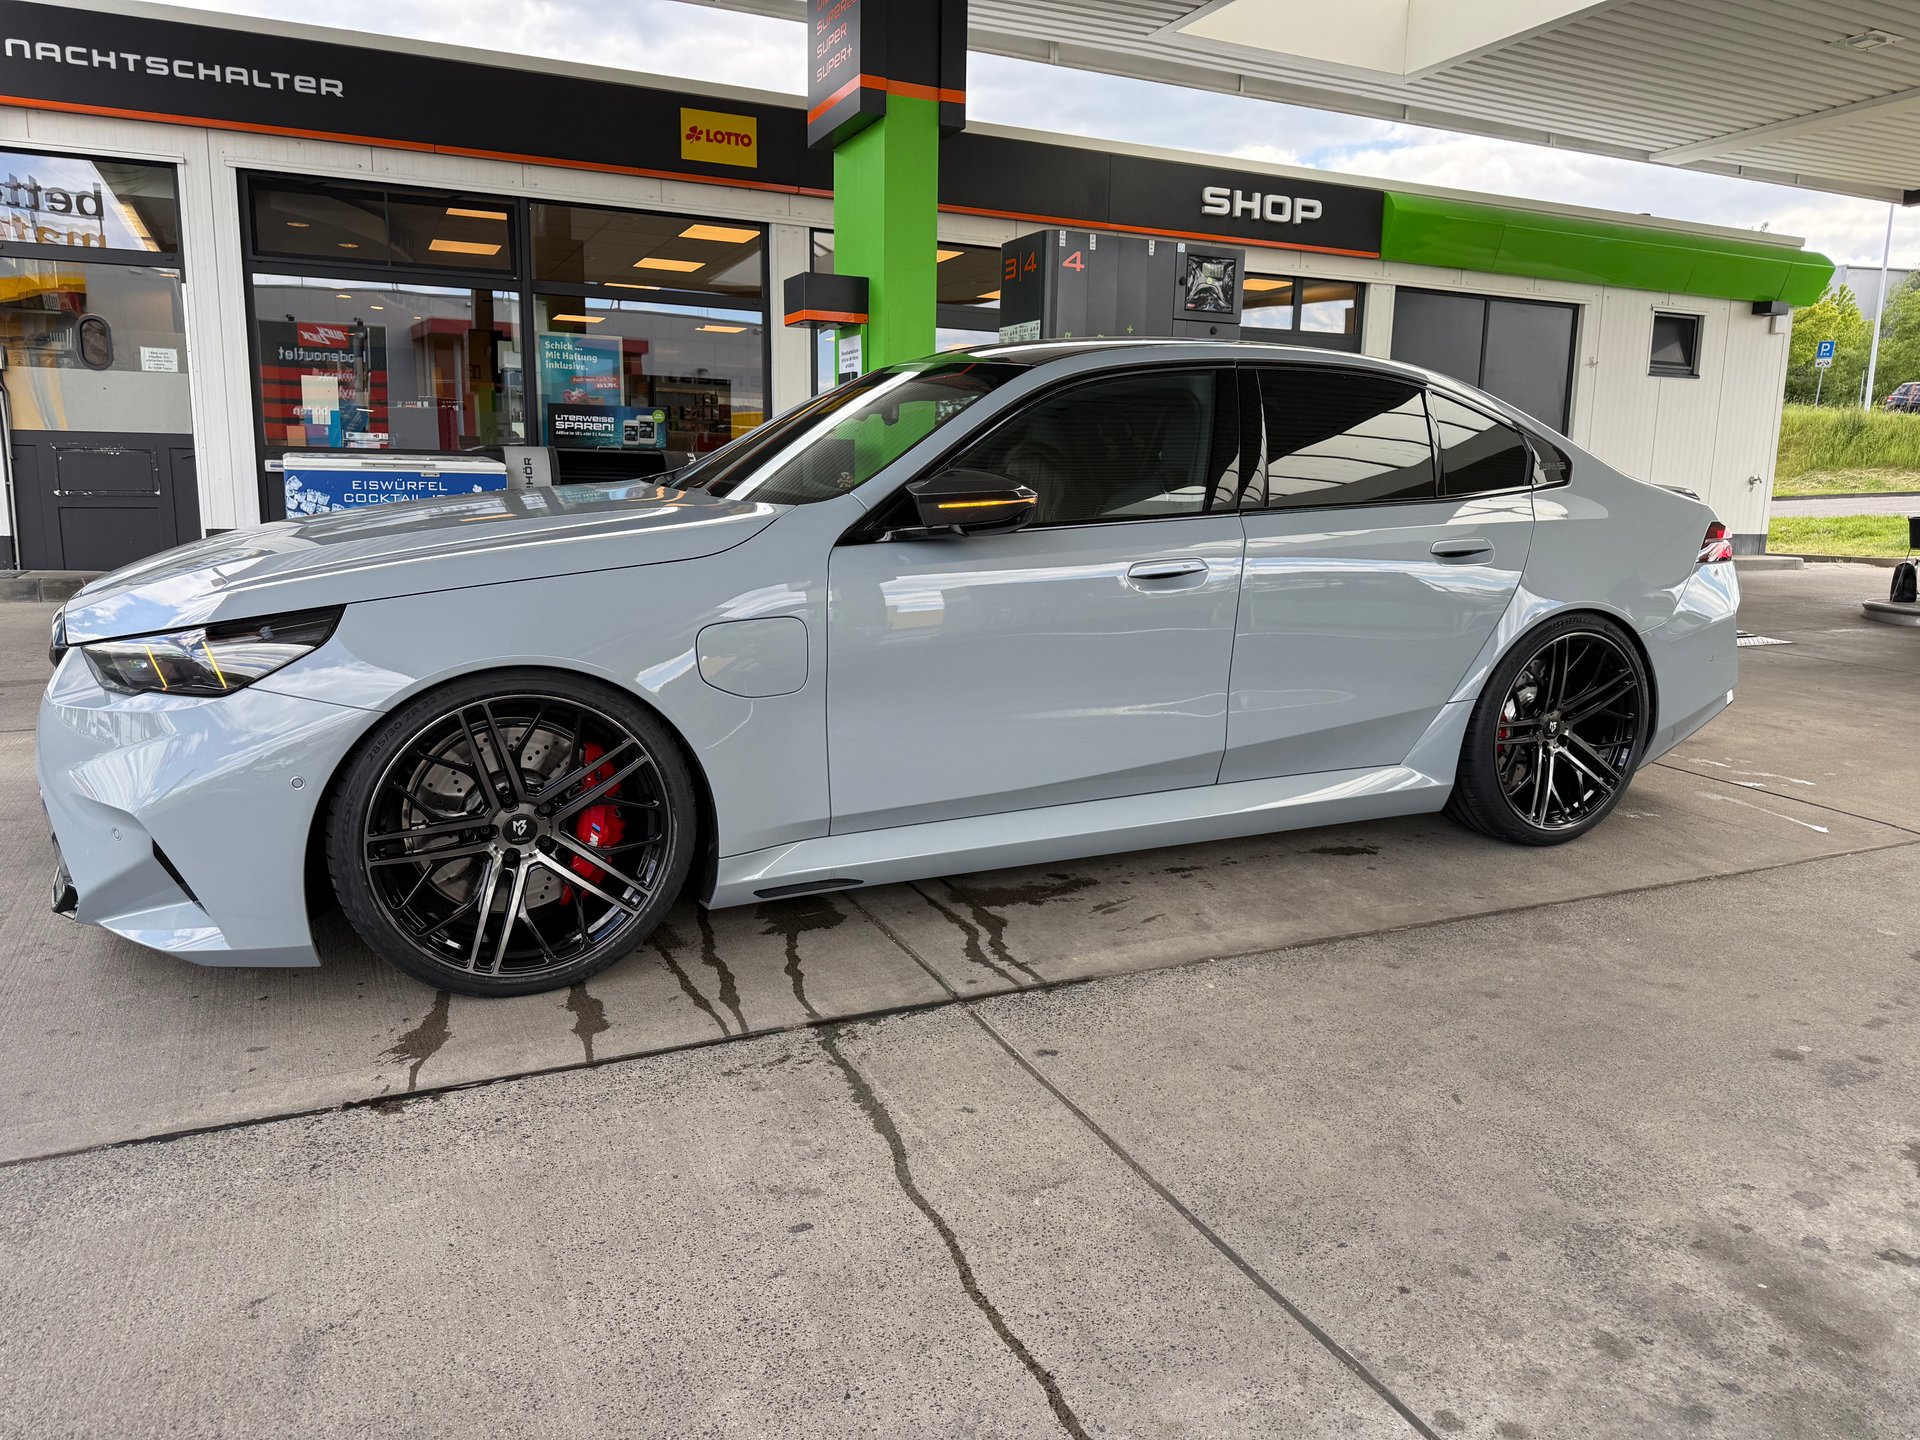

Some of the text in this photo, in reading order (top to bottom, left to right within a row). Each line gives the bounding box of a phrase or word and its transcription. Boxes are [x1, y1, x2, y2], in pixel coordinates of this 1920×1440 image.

[816, 22, 847, 59] SUPER
[5, 38, 344, 98] NACHTSCHALTER
[816, 43, 853, 83] SUPER+
[705, 129, 752, 148] LOTTO
[1201, 186, 1323, 225] SHOP
[1062, 251, 1085, 272] 4
[544, 341, 573, 350] Schick
[1820, 343, 1831, 356] P
[545, 351, 598, 363] Mit Haftung
[545, 360, 589, 371] inklusive.
[555, 414, 615, 423] LITERWEISE
[555, 421, 615, 431] SPAREN!
[523, 457, 534, 488] HÖR
[352, 478, 449, 491] EISWÜRFEL
[366, 721, 403, 762] 285/30
[403, 708, 420, 722] ZR
